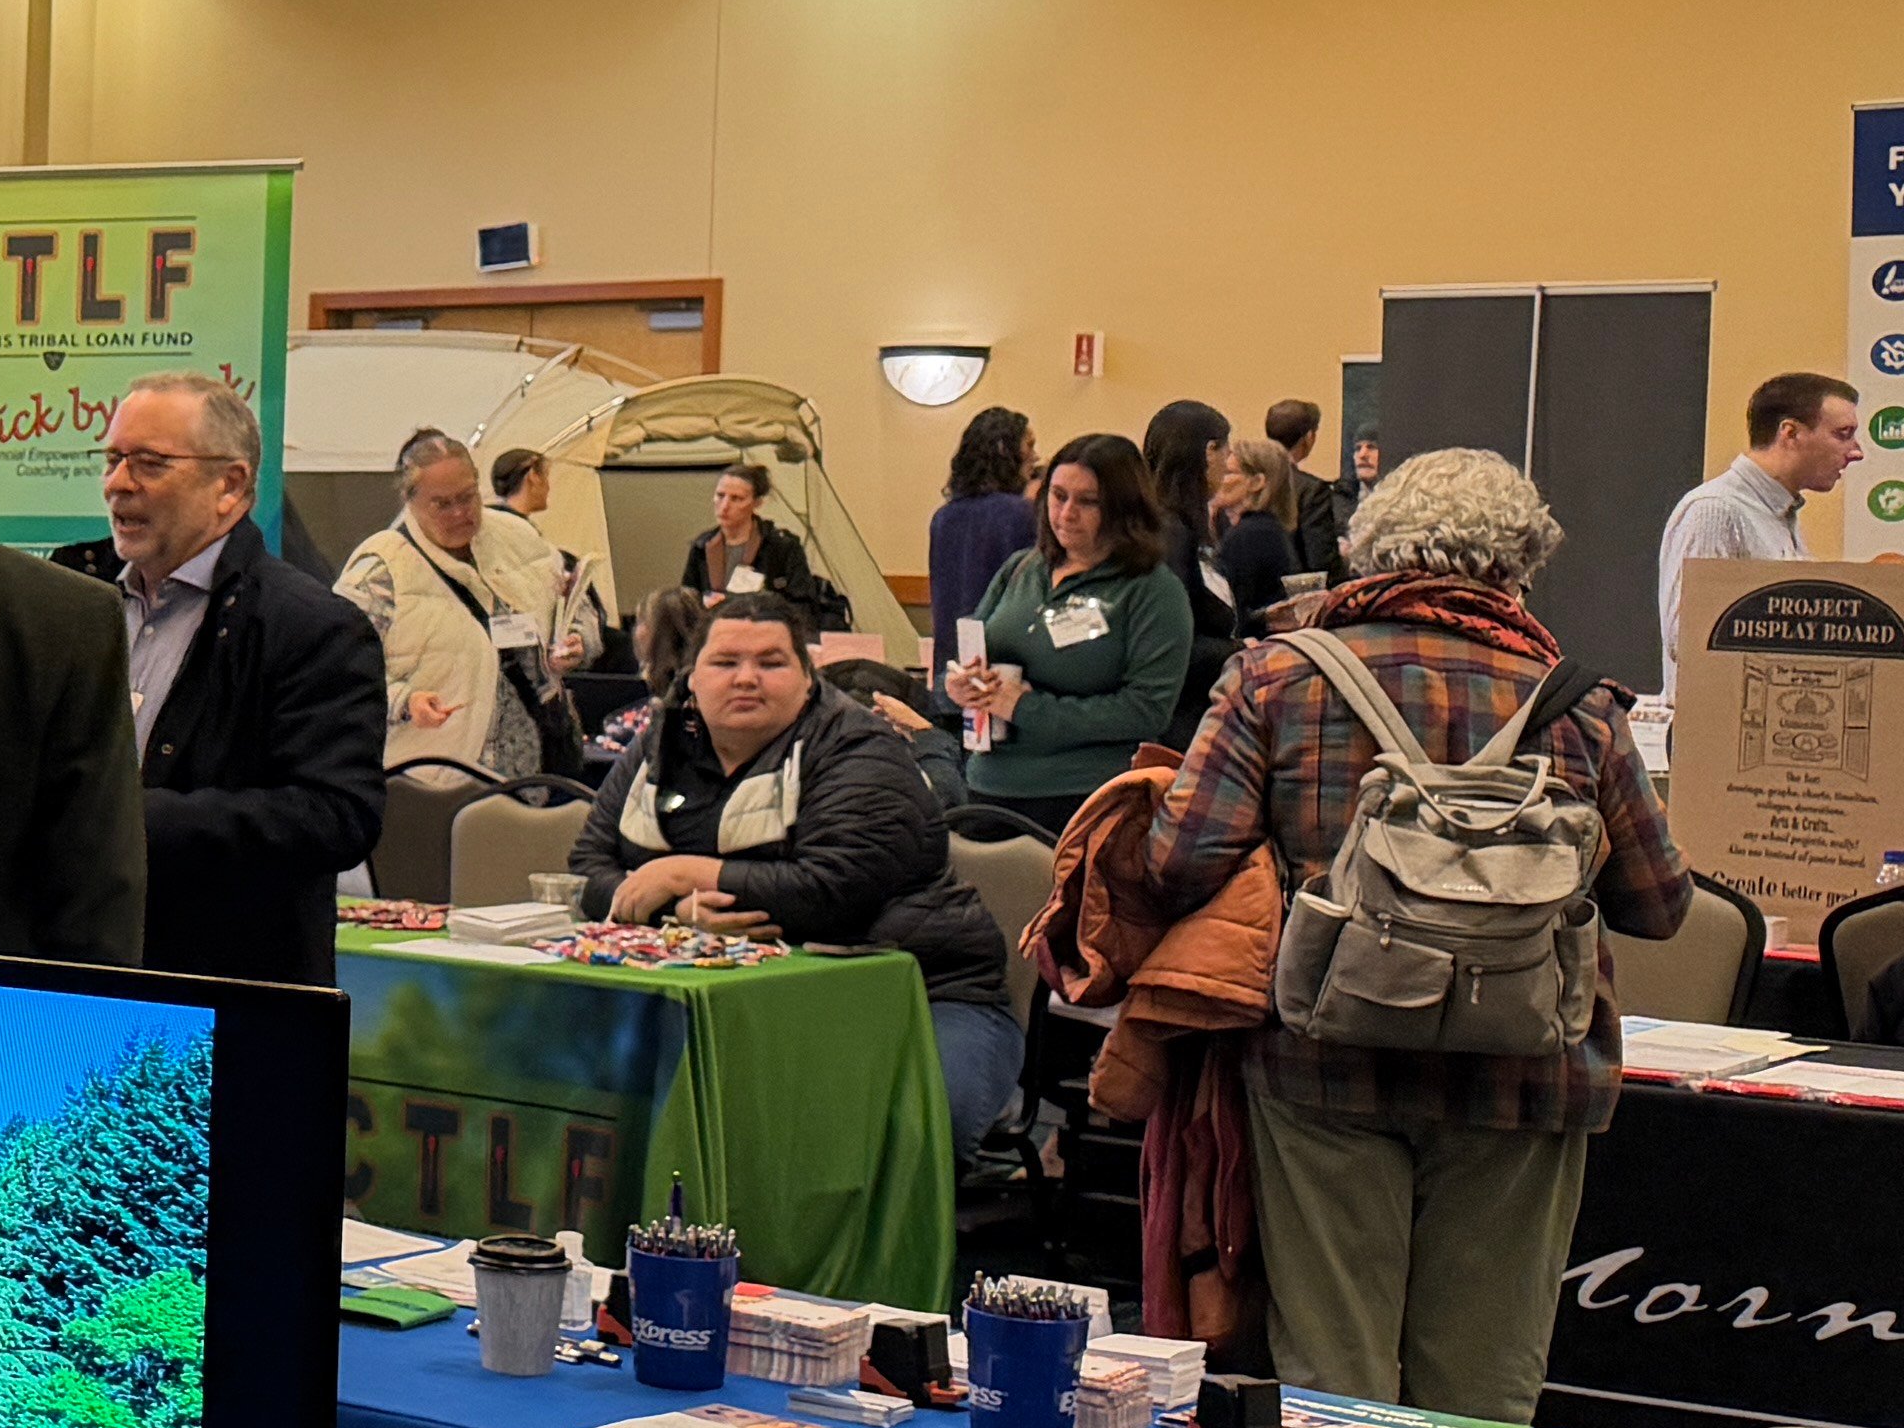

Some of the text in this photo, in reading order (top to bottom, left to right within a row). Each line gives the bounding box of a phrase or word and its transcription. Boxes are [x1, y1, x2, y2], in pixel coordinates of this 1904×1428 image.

[19, 333, 79, 348] TRIBAL
[85, 332, 135, 347] LOAN
[141, 331, 193, 347] FUND
[68, 386, 120, 442] by
[1767, 596, 1862, 618] PROJECT
[1733, 618, 1896, 645] DISPLAY BOARD
[1711, 870, 1778, 899] Create
[1782, 880, 1824, 902] better
